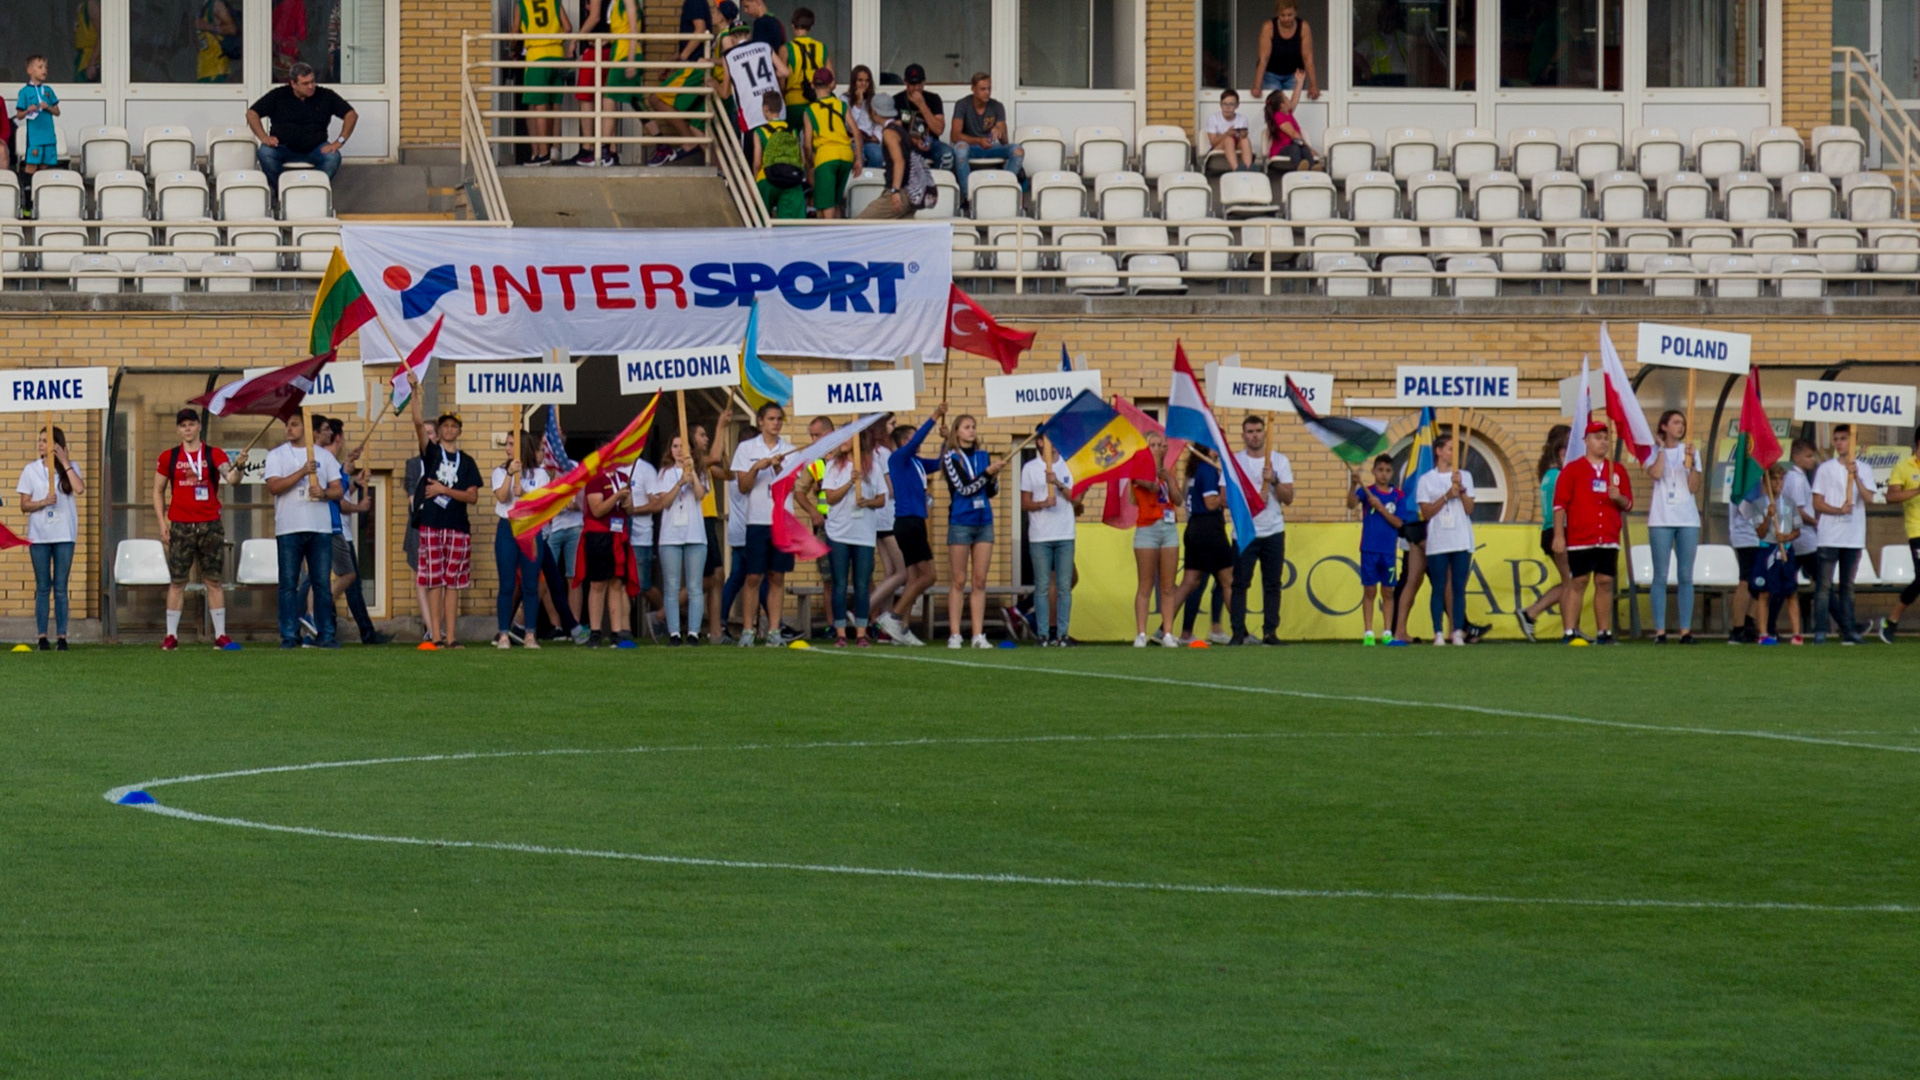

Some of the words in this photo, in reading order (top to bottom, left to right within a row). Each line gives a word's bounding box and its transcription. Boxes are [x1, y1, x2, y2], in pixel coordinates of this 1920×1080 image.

[532, 0, 549, 28] 5
[741, 56, 773, 88] 14
[469, 261, 904, 316] INTERSPORT
[1660, 334, 1729, 361] POLAND
[627, 354, 732, 382] MACEDONIA
[12, 378, 83, 401] FRANCE
[467, 372, 564, 393] LITHUANIA
[827, 382, 883, 403] MALTA
[1015, 386, 1073, 403] MOLDOVA
[1404, 375, 1509, 397] PALESTINE
[1806, 391, 1903, 416] PORTUGAL
